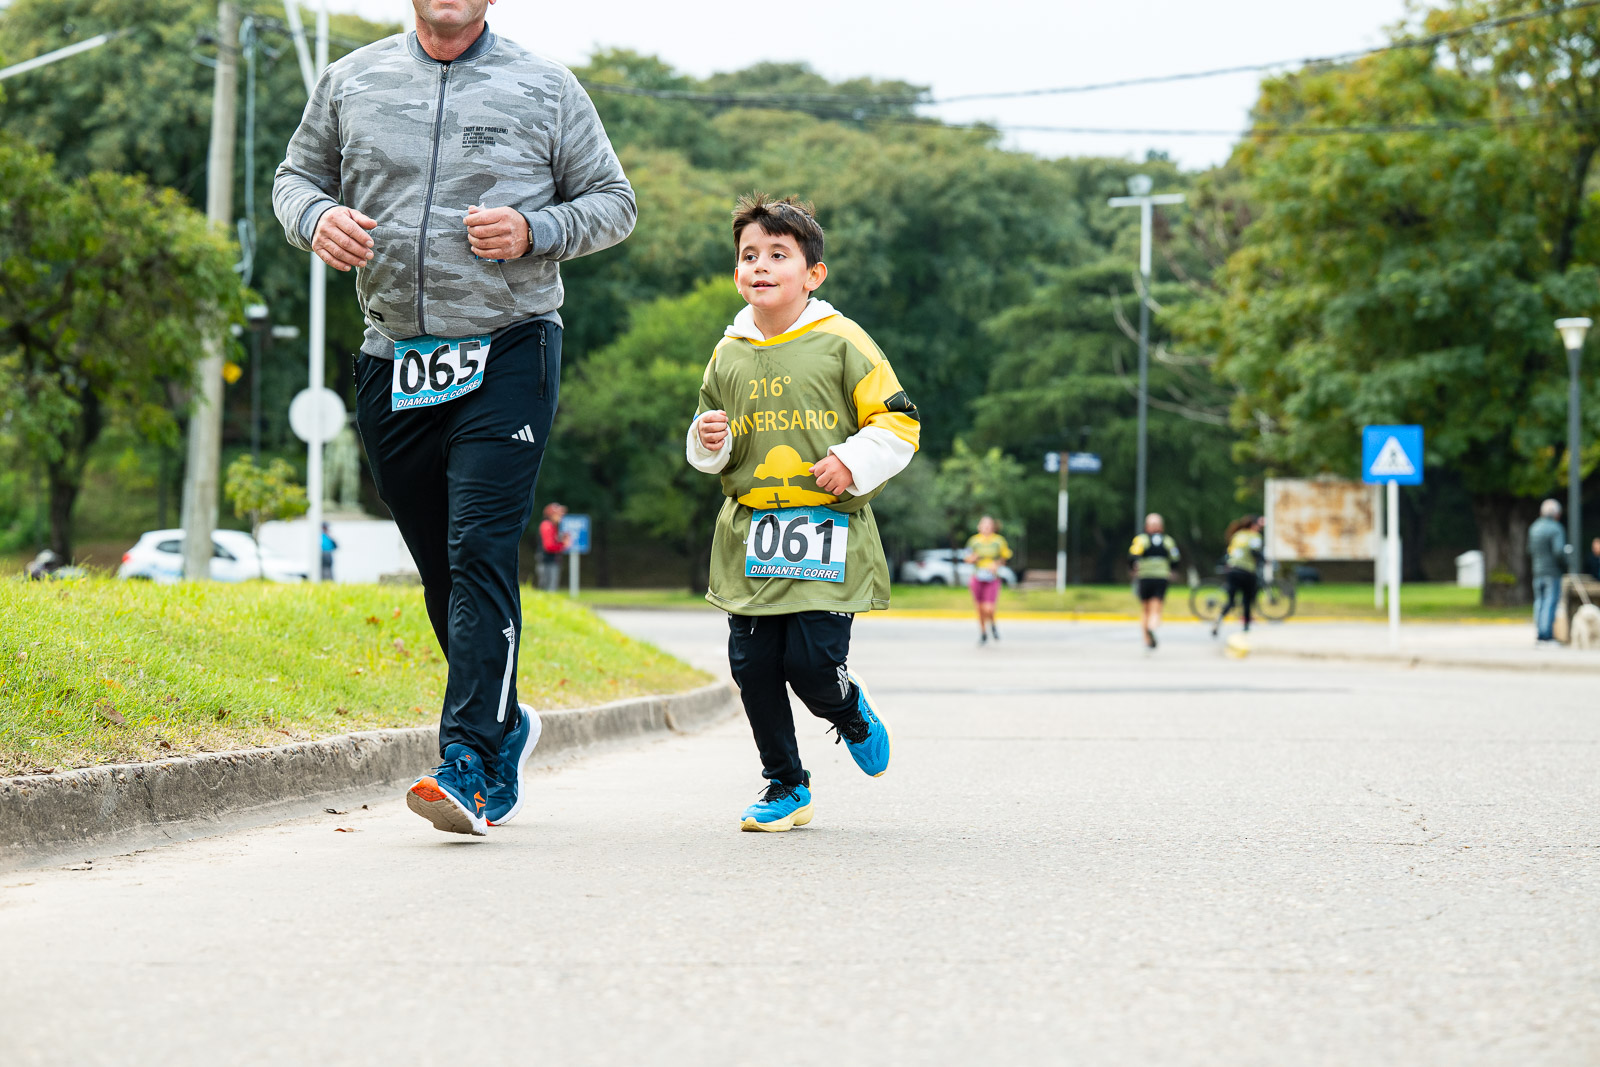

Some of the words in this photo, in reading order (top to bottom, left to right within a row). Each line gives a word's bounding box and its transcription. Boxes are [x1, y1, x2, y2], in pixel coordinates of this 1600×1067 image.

[400, 340, 480, 395] 065
[396, 392, 449, 408] DIAMANTE
[450, 378, 480, 398] CORRE
[731, 410, 838, 438] NIVERSARIO
[754, 513, 834, 565] 061
[750, 565, 802, 576] DIAMANTE
[803, 568, 839, 579] CORRE
